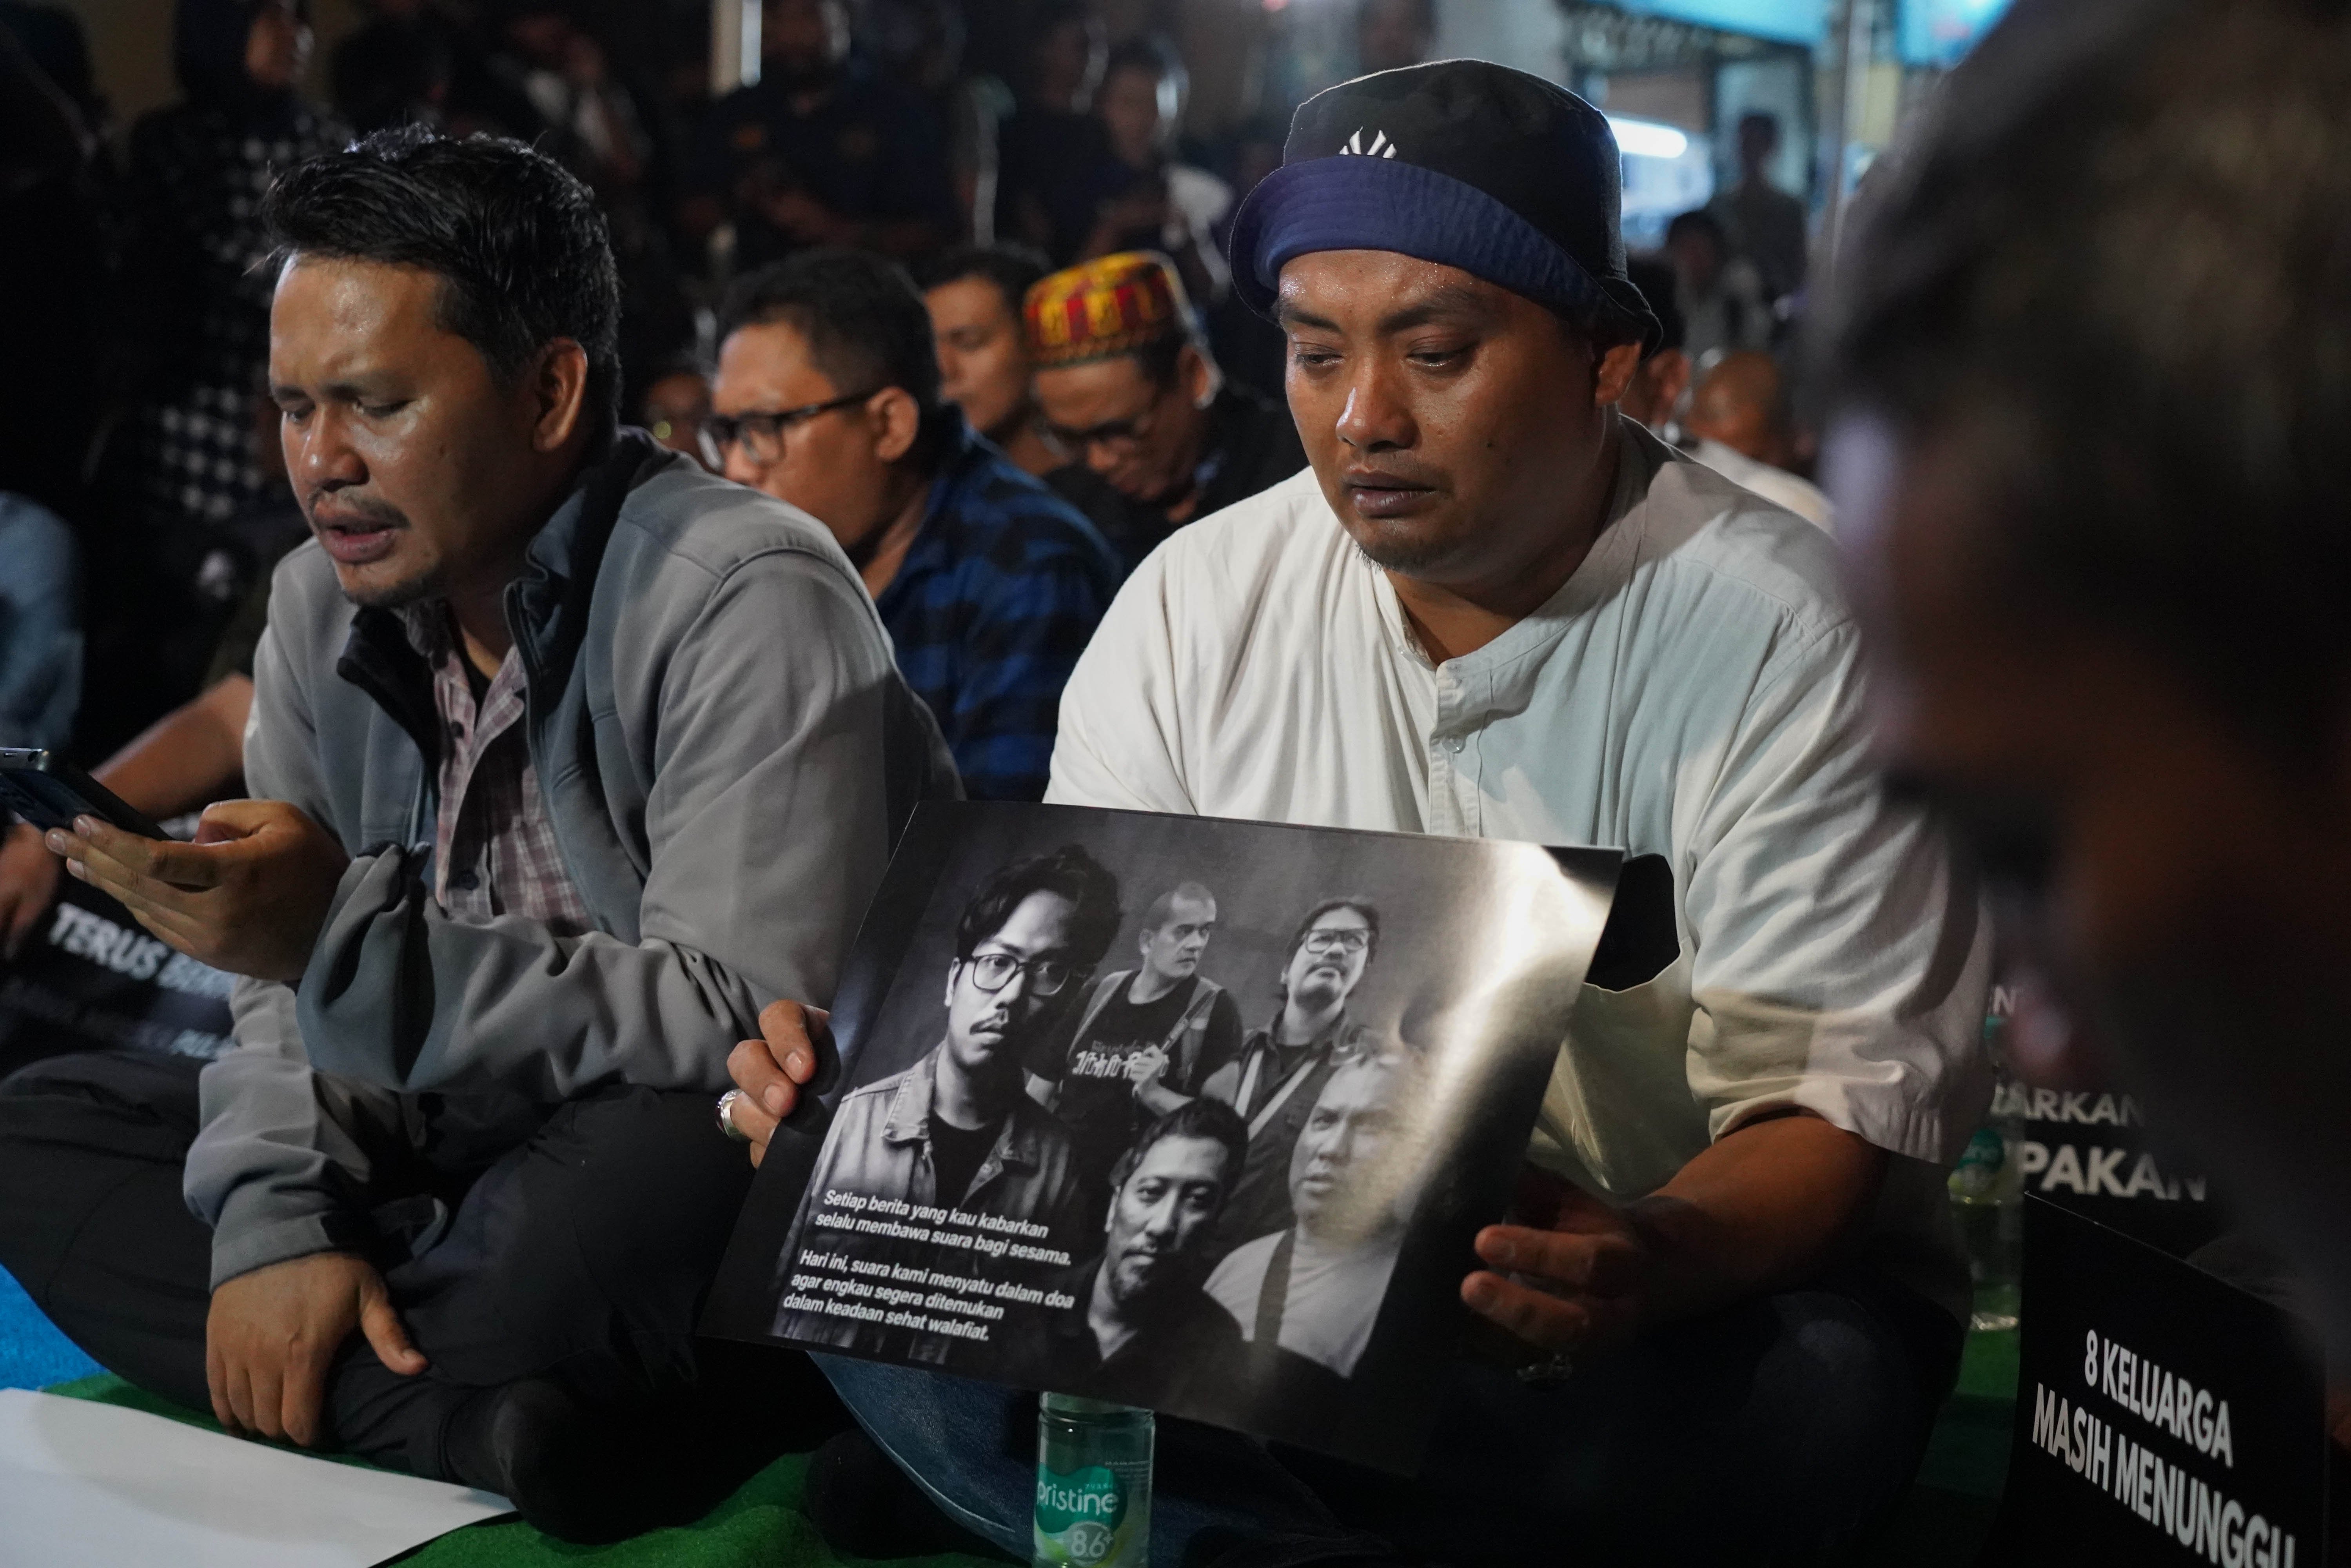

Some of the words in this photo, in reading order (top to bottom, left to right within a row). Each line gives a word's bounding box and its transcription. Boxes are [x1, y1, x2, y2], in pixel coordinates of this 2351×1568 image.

[49, 902, 169, 980] TERUS
[2003, 1140, 2206, 1202] PAKAN
[815, 1212, 856, 1230] selalu
[856, 1221, 930, 1241] membawa
[931, 1230, 973, 1249] suara
[974, 1234, 1010, 1258] bagi
[1009, 1244, 1071, 1266] sesama.
[824, 1189, 867, 1212] Setiap
[868, 1195, 910, 1215] berita
[909, 1205, 948, 1225] yang
[948, 1207, 977, 1226] kau
[977, 1212, 1049, 1238] kabarkan
[791, 1274, 823, 1291] agar
[823, 1278, 874, 1297] engkau
[874, 1286, 924, 1306] segera
[924, 1293, 1005, 1320] ditemukan
[799, 1249, 830, 1268] Hari
[828, 1253, 848, 1273] ini,
[851, 1260, 890, 1277] suara
[891, 1263, 930, 1284] kami
[928, 1273, 995, 1294] menyatu
[995, 1281, 1044, 1304] dalam
[1044, 1290, 1075, 1309] doa
[784, 1293, 824, 1312] dalam
[824, 1298, 884, 1321] keadaan
[885, 1310, 928, 1330] sehat
[928, 1318, 989, 1341] walafiat.
[2084, 1329, 2098, 1387] 8
[2102, 1338, 2234, 1469] KELUARGA
[2032, 1382, 2111, 1492] MASIH
